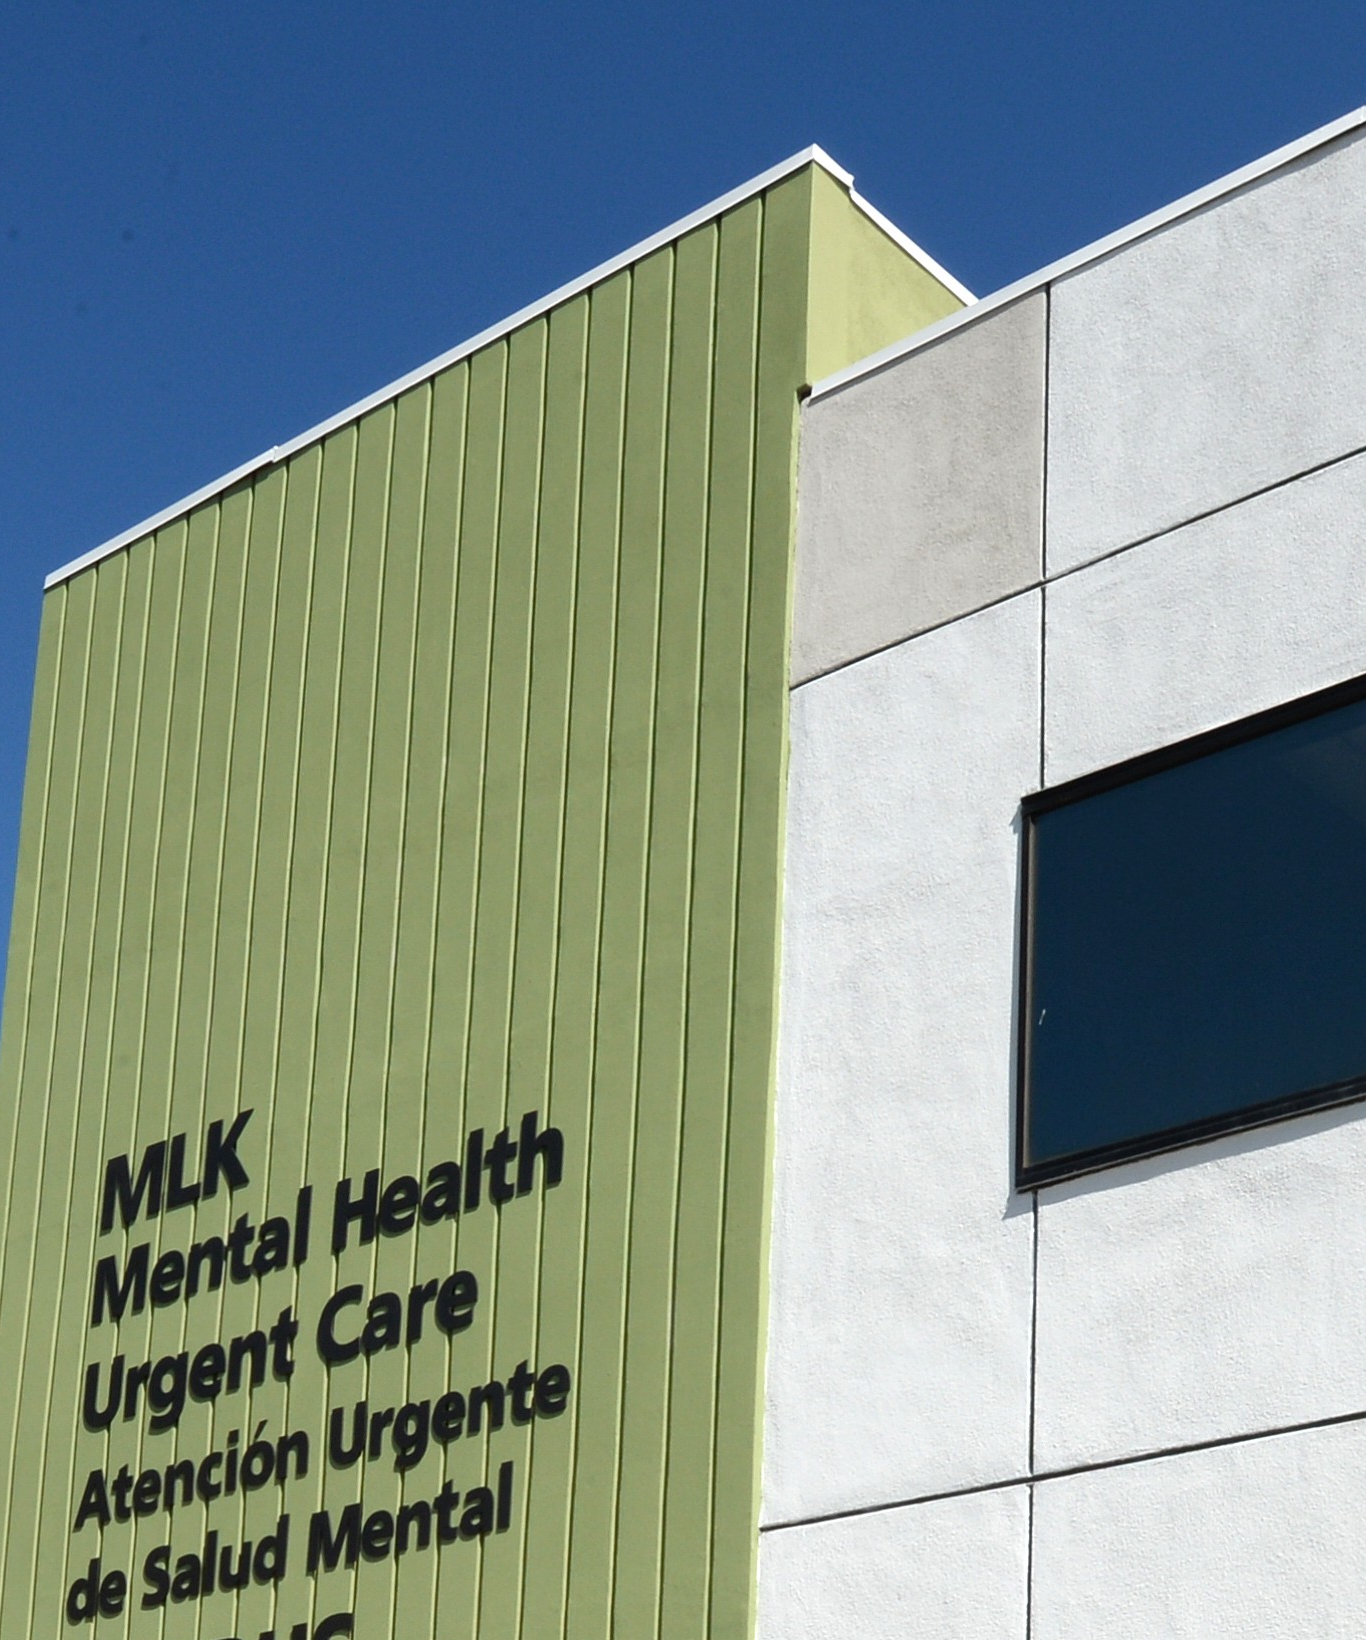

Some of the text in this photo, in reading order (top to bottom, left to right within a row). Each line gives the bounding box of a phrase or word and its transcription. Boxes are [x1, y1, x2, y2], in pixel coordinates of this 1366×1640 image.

[90, 1110, 564, 1326] Mental Health
[99, 1108, 254, 1235] MLK
[82, 1270, 478, 1432] Urgent Care
[73, 1360, 571, 1531] Atención Urgente
[66, 1461, 513, 1623] de Salud Mental
